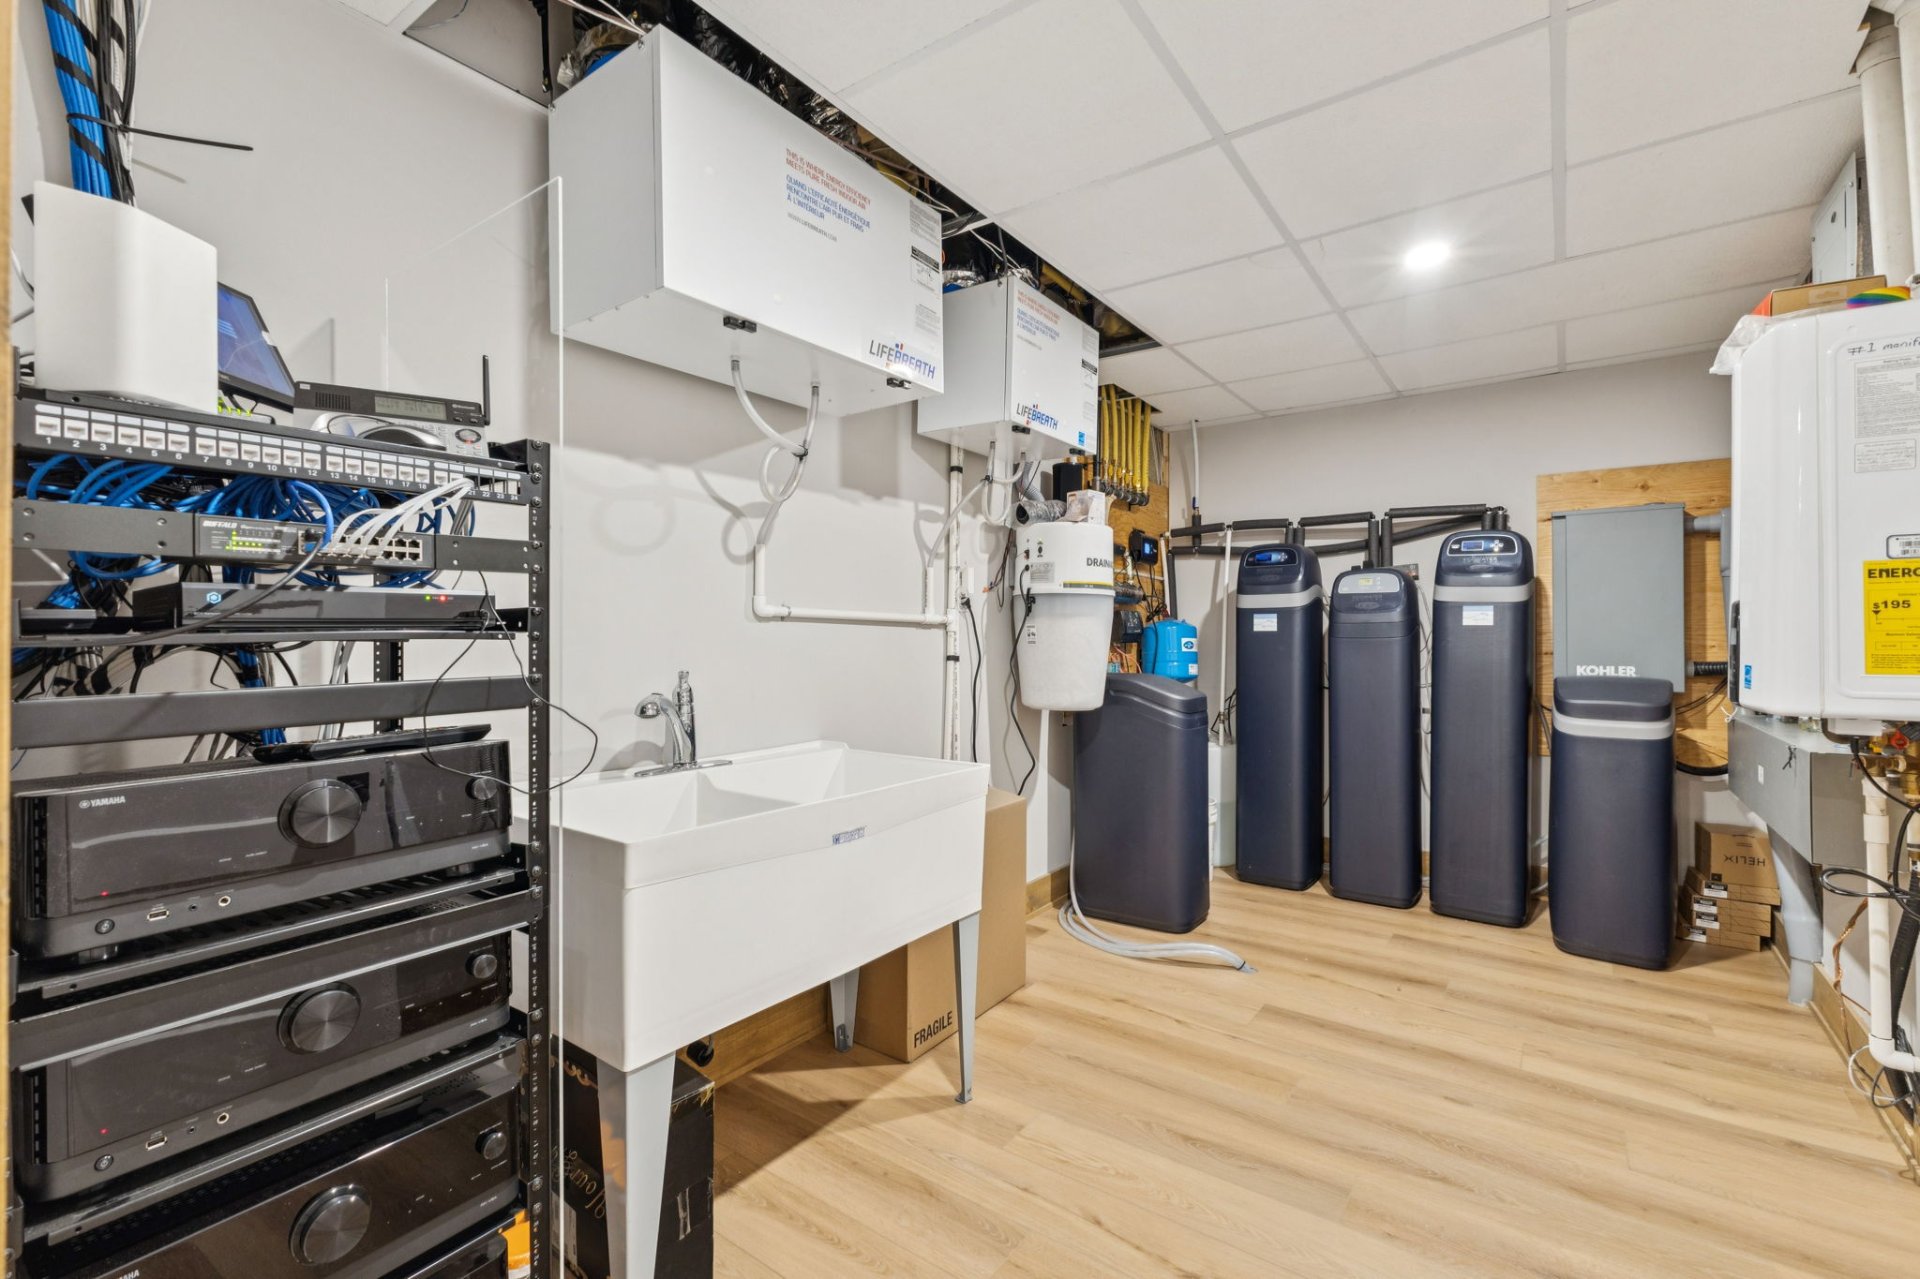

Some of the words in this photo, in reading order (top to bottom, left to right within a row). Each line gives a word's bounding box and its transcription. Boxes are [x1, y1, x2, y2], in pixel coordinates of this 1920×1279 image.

[869, 339, 936, 379] LIFEBREATH
[1016, 402, 1059, 431] LIFEBREATH
[202, 520, 238, 529] BUFFALO
[1086, 557, 1113, 568] DRAIN
[1873, 600, 1911, 609] $195
[1576, 665, 1636, 677] KOHLER
[90, 795, 126, 807] YAMAHA
[1723, 855, 1765, 867] HELIX
[913, 1010, 952, 1048] FRAGILE
